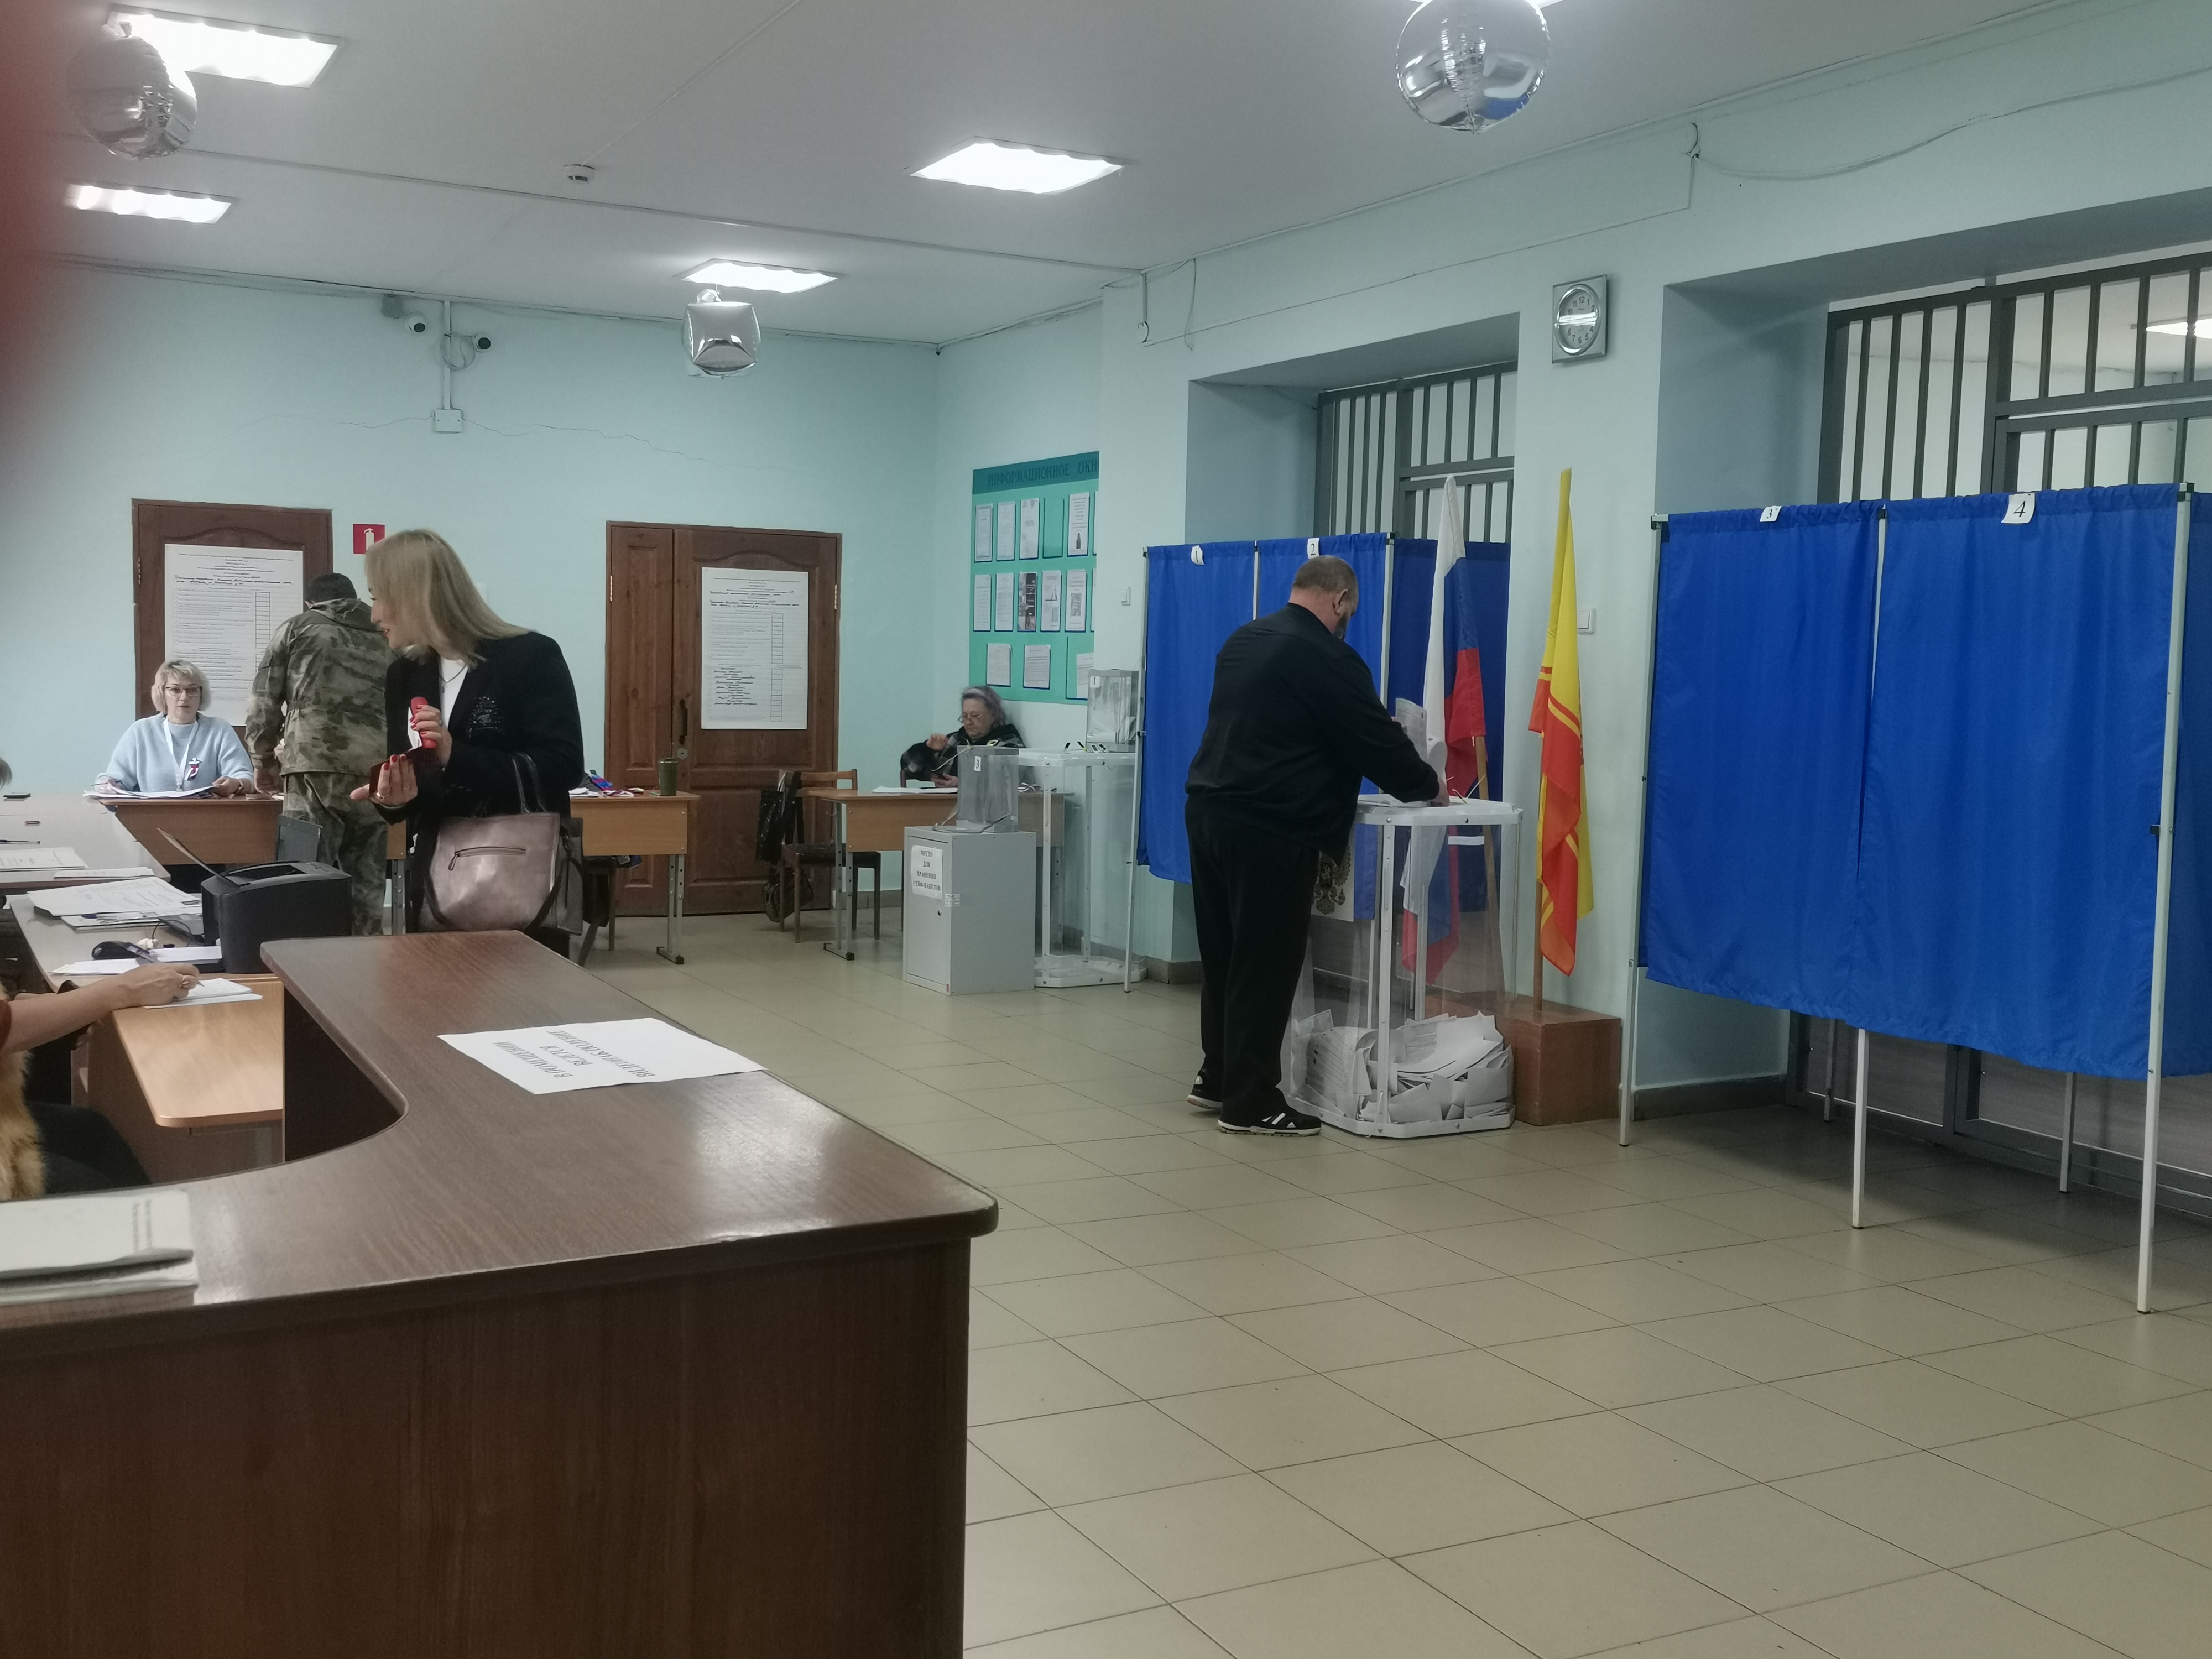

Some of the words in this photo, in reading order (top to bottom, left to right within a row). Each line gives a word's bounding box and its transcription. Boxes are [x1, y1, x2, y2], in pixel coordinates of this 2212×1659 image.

[1567, 328, 1572, 336] 8
[1571, 334, 1575, 342] 7
[988, 463, 1070, 487] ИНФОРМАЦИОННОЕ
[1766, 509, 1773, 519] 3
[2013, 500, 2026, 517] 4
[1196, 550, 1199, 562] 1
[1311, 543, 1316, 556] 2
[492, 1041, 565, 1074] ПОМЕЩЕНИИ
[539, 1045, 593, 1066] ВЕДЕТСЯ
[546, 1031, 656, 1078] ВИДЕОНАБЛЮДЕНИЕ
